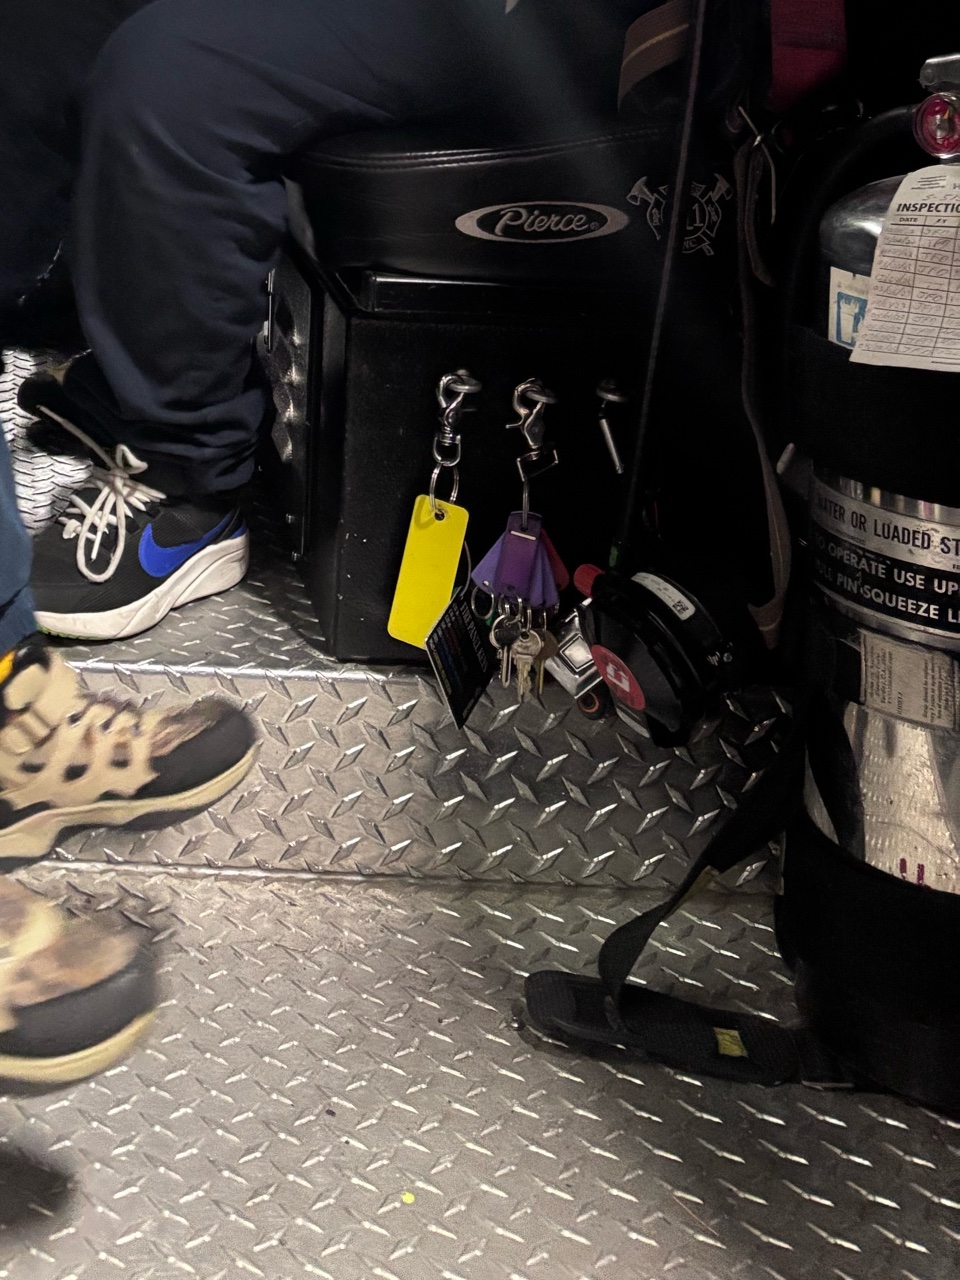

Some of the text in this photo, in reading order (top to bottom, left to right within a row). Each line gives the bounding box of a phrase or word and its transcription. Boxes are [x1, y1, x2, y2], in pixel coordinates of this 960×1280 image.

[494, 207, 589, 236] Pierce
[851, 511, 867, 533] OR
[828, 542, 887, 579] OPERATE
[893, 568, 926, 590] USE
[933, 578, 959, 596] UP
[836, 573, 859, 595] PIN
[861, 584, 940, 621] SQUEEZE
